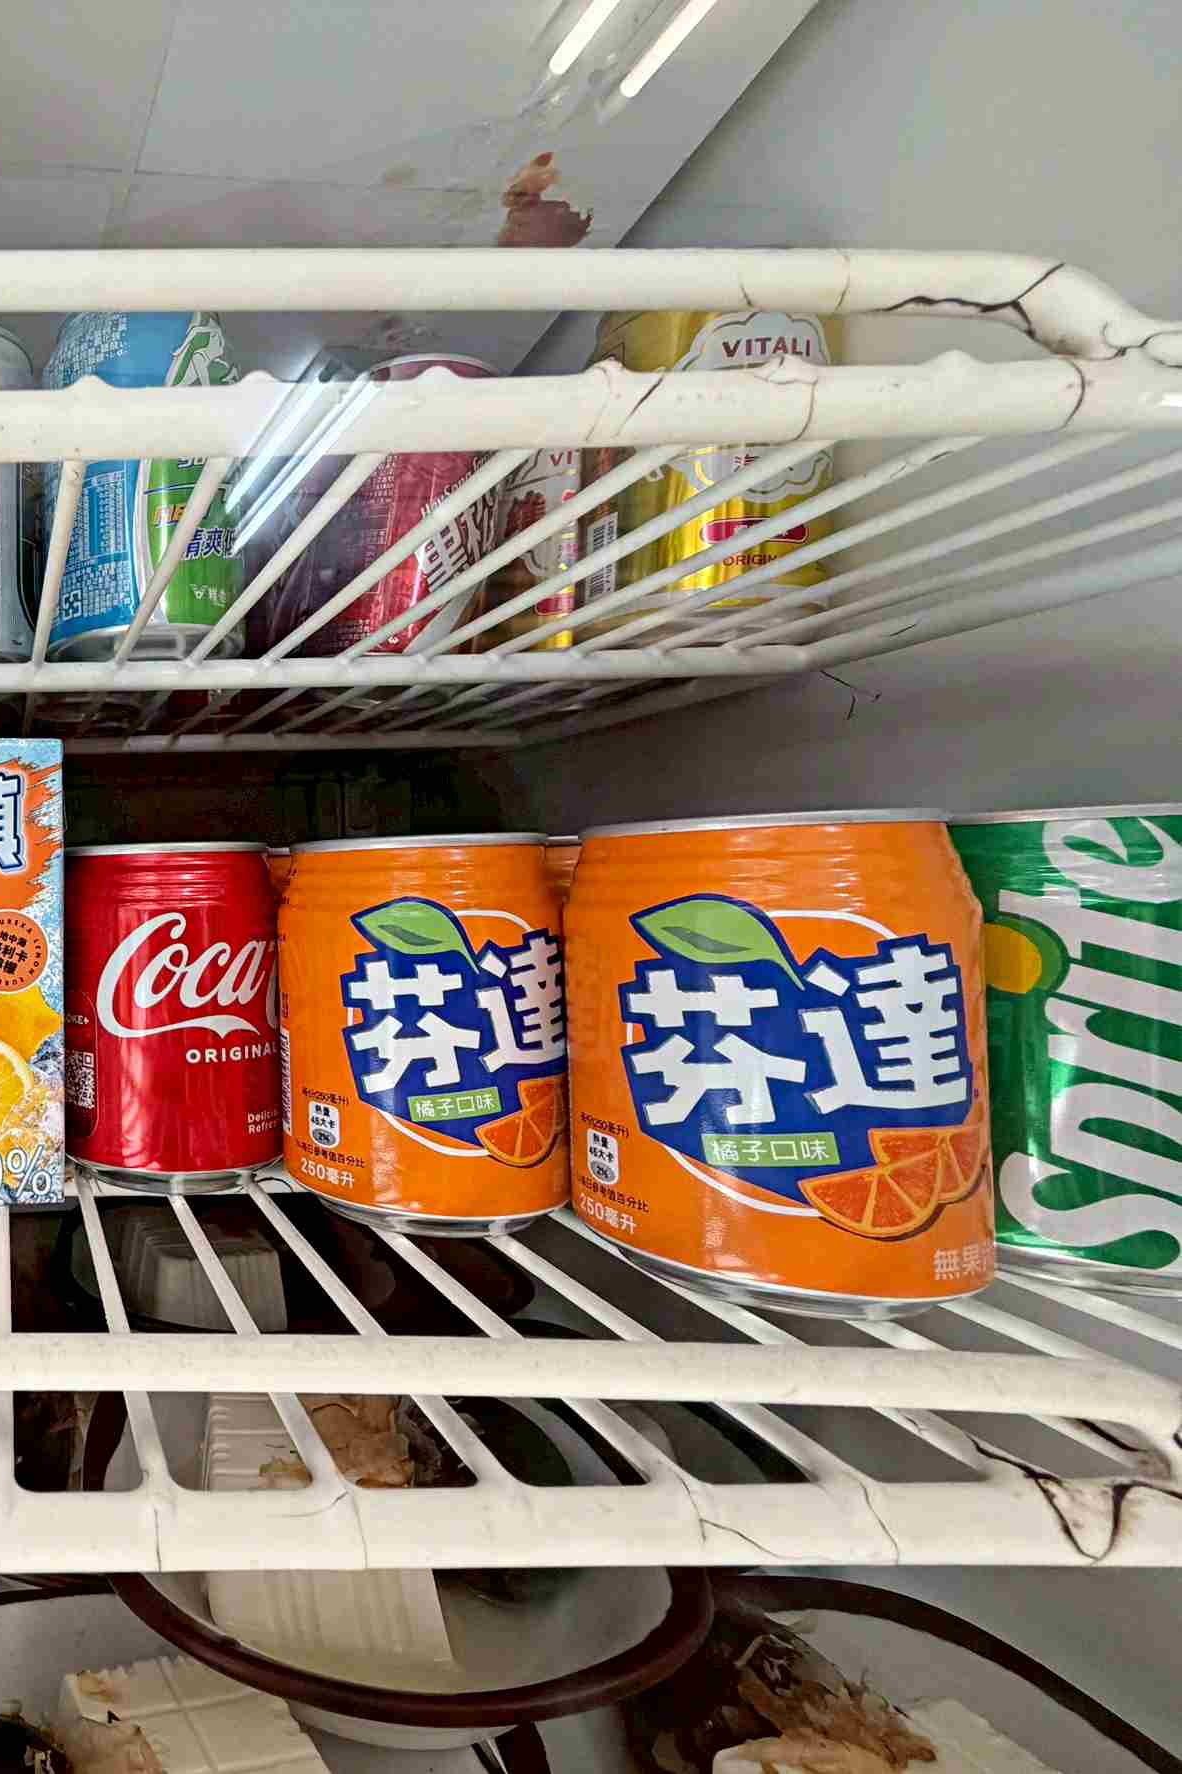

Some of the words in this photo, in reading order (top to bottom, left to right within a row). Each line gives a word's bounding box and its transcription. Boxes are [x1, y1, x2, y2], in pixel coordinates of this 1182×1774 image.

[722, 336, 811, 358] VITALI
[348, 936, 568, 1095] 芬達
[629, 945, 967, 1126] 芬達
[415, 1093, 498, 1119] 橘子口味
[710, 1138, 830, 1163] 橘子口味
[300, 1157, 355, 1189] 250毫升
[578, 1192, 637, 1235] 250毫升
